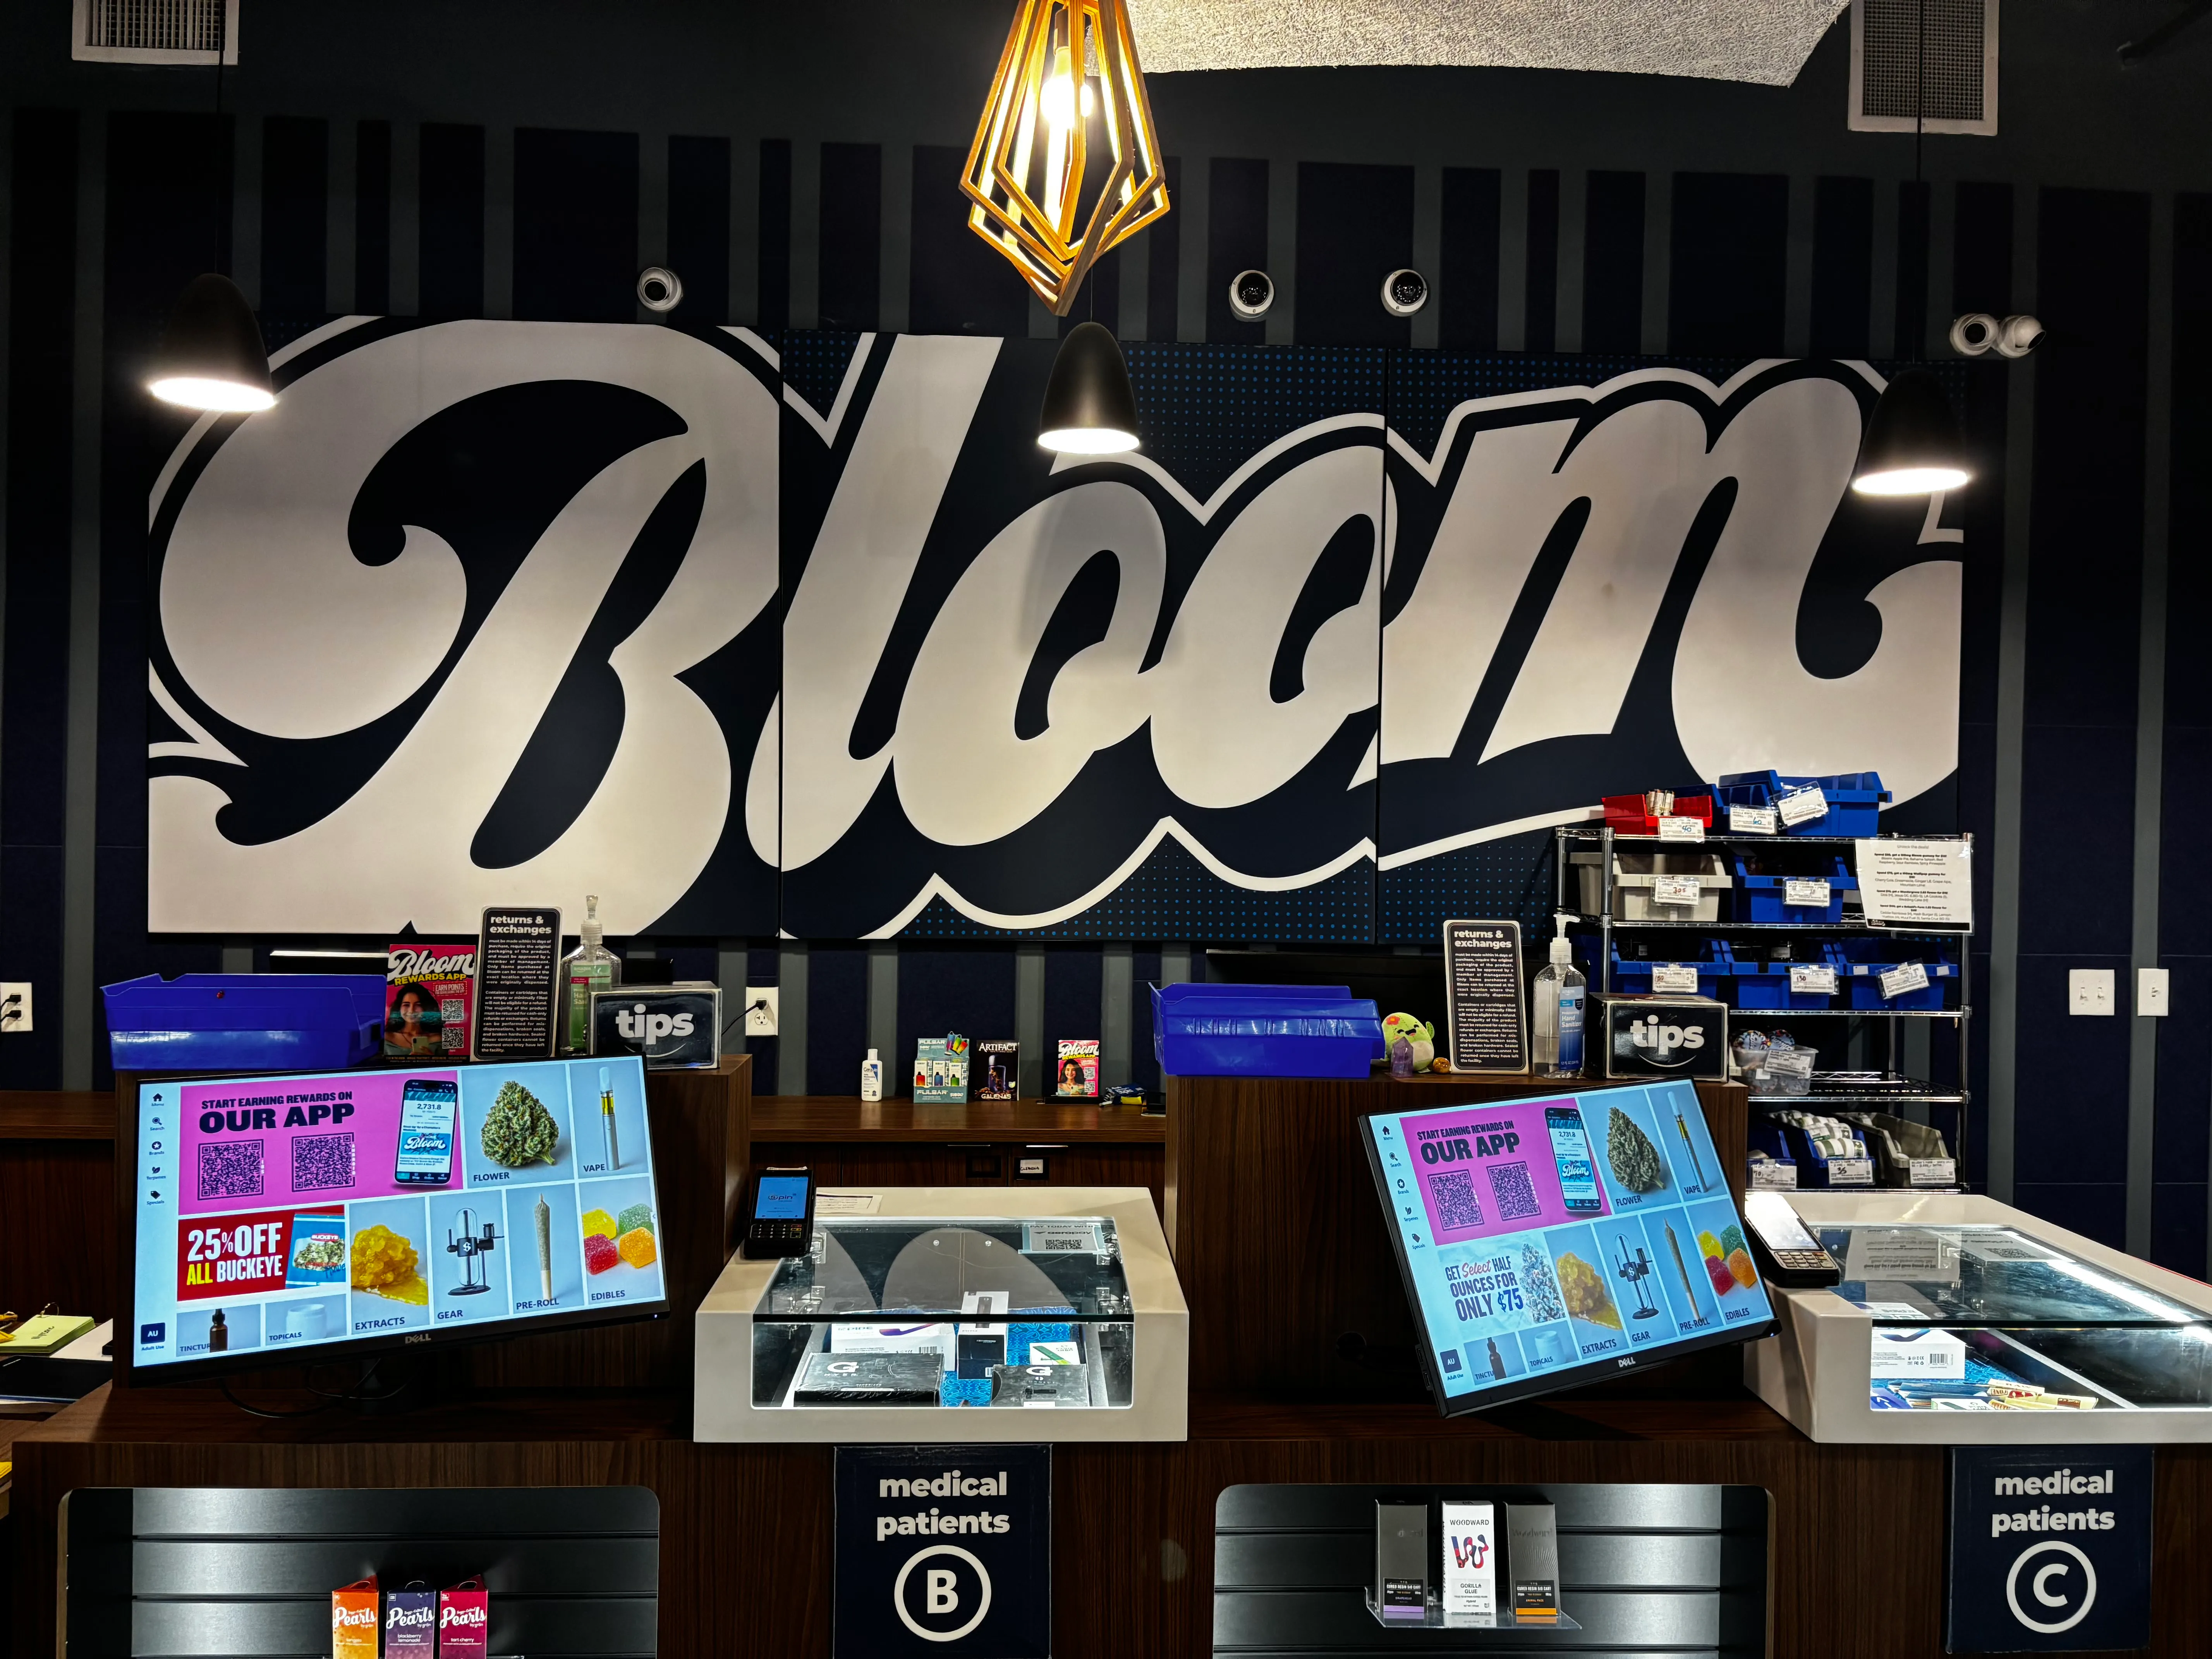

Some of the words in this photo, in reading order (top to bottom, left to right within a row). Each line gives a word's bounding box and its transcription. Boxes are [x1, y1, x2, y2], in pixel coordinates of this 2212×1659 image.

[148, 316, 1963, 935] Bloom
[490, 925, 551, 935] exchanges
[1455, 939, 1512, 949] exchanges
[387, 949, 475, 982] Bloom
[395, 974, 445, 986] REWARDS
[615, 1003, 694, 1045] tips
[1630, 1015, 1704, 1055] tips
[979, 1042, 1017, 1052] ARTIFACT
[1058, 1042, 1099, 1058] Bloom
[201, 1098, 236, 1109] START
[238, 1096, 284, 1107] EARNING
[287, 1092, 336, 1104] REWARDS
[338, 1091, 352, 1101] ON
[199, 1108, 276, 1133] OUR
[284, 1103, 355, 1128] APP
[1417, 1131, 1439, 1141] START
[1441, 1126, 1471, 1137] EARNING
[1472, 1122, 1504, 1134] REWARDS
[1504, 1120, 1515, 1130] ON
[404, 1136, 446, 1149] Bloom
[1420, 1138, 1474, 1165] OUR
[1477, 1132, 1520, 1158] APP
[583, 1164, 605, 1172] VAPE
[1562, 1164, 1589, 1177] Bloom
[473, 1172, 510, 1182] FLOWER
[1684, 1185, 1700, 1195] VAPE
[1616, 1195, 1642, 1207] FLOWER
[187, 1264, 213, 1285] ALL
[216, 1255, 283, 1282] BUCKEYE
[1445, 1266, 1462, 1281] GET
[1462, 1259, 1491, 1278] Select
[1492, 1255, 1512, 1271] HALF
[1450, 1277, 1495, 1298] OUNCES
[1495, 1271, 1518, 1289] FOR
[591, 1290, 625, 1301] EDIBLES
[516, 1298, 560, 1310] PRE-ROLL
[1455, 1293, 1493, 1321] ONLY
[1497, 1287, 1523, 1313] $75
[437, 1309, 463, 1320] GEAR
[1725, 1307, 1750, 1320] EDIBLES
[355, 1316, 405, 1331] EXTRACTS
[1679, 1317, 1710, 1331] PRE-ROLL
[269, 1331, 302, 1341] TOPICALS
[405, 1333, 431, 1344] DELL
[1632, 1331, 1651, 1342] GEAR
[180, 1343, 211, 1352] TINCTUR
[1582, 1339, 1617, 1354] EXTRACTS
[1530, 1356, 1553, 1367] TOPICALS
[1618, 1357, 1636, 1367] DELL
[1475, 1371, 1494, 1379] TINCTU
[879, 1470, 1007, 1497] medical
[1995, 1468, 2113, 1495] medical
[877, 1508, 1010, 1541] patients
[1992, 1505, 2115, 1537] patients
[927, 1570, 958, 1614] B
[2033, 1563, 2069, 1607] C
[333, 1607, 376, 1627] Pearls
[386, 1607, 435, 1629] Pearls
[440, 1607, 487, 1628] Pearls
